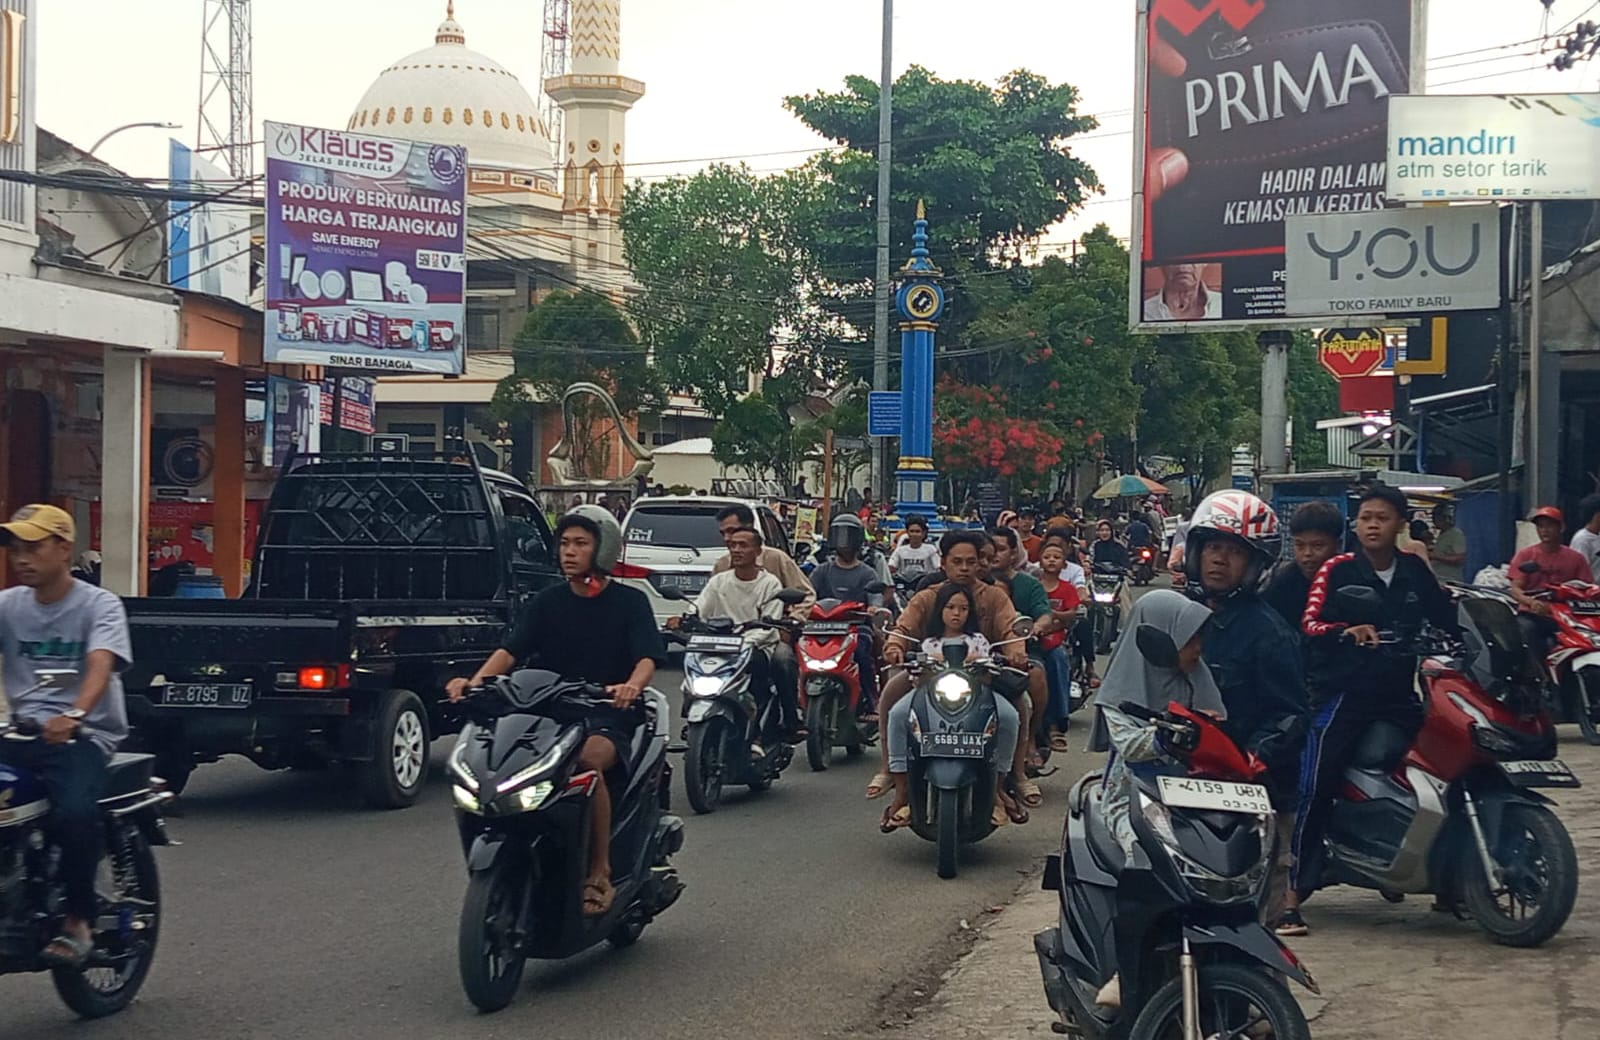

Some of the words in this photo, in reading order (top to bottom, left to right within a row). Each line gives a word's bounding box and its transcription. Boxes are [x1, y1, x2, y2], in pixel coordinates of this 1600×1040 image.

[1186, 43, 1389, 138] PRIMA
[300, 126, 395, 163] Kläuss
[1397, 129, 1515, 156] mandiri
[299, 153, 332, 165] JELAS
[338, 160, 393, 173] BERKELAS
[1396, 161, 1434, 178] atm
[1442, 161, 1495, 178] setor
[1502, 159, 1548, 177] tarik
[1260, 167, 1316, 195] HADIR
[1319, 161, 1386, 191] DALAM
[278, 179, 352, 204] PRODUK
[356, 189, 462, 216] BERKUALITAS
[1223, 196, 1309, 225] KEMASAN
[1314, 191, 1385, 215] KERTAS
[281, 204, 346, 228] HARGA
[350, 211, 458, 239] TERJANGKAU
[312, 232, 339, 246] SAVE
[340, 234, 380, 250] ENERGY
[1307, 223, 1480, 281] Y.O.U
[1328, 300, 1365, 311] TOKO
[1369, 298, 1414, 310] FAMILY
[1417, 296, 1452, 307] BARU
[329, 355, 365, 366] SINAR
[365, 357, 413, 370] BAHAGIA
[186, 686, 219, 702] 8795
[232, 686, 249, 702] UZ
[922, 735, 929, 745] F
[962, 734, 982, 745] UAX
[1162, 778, 1172, 790] F
[1234, 784, 1265, 798] UBK
